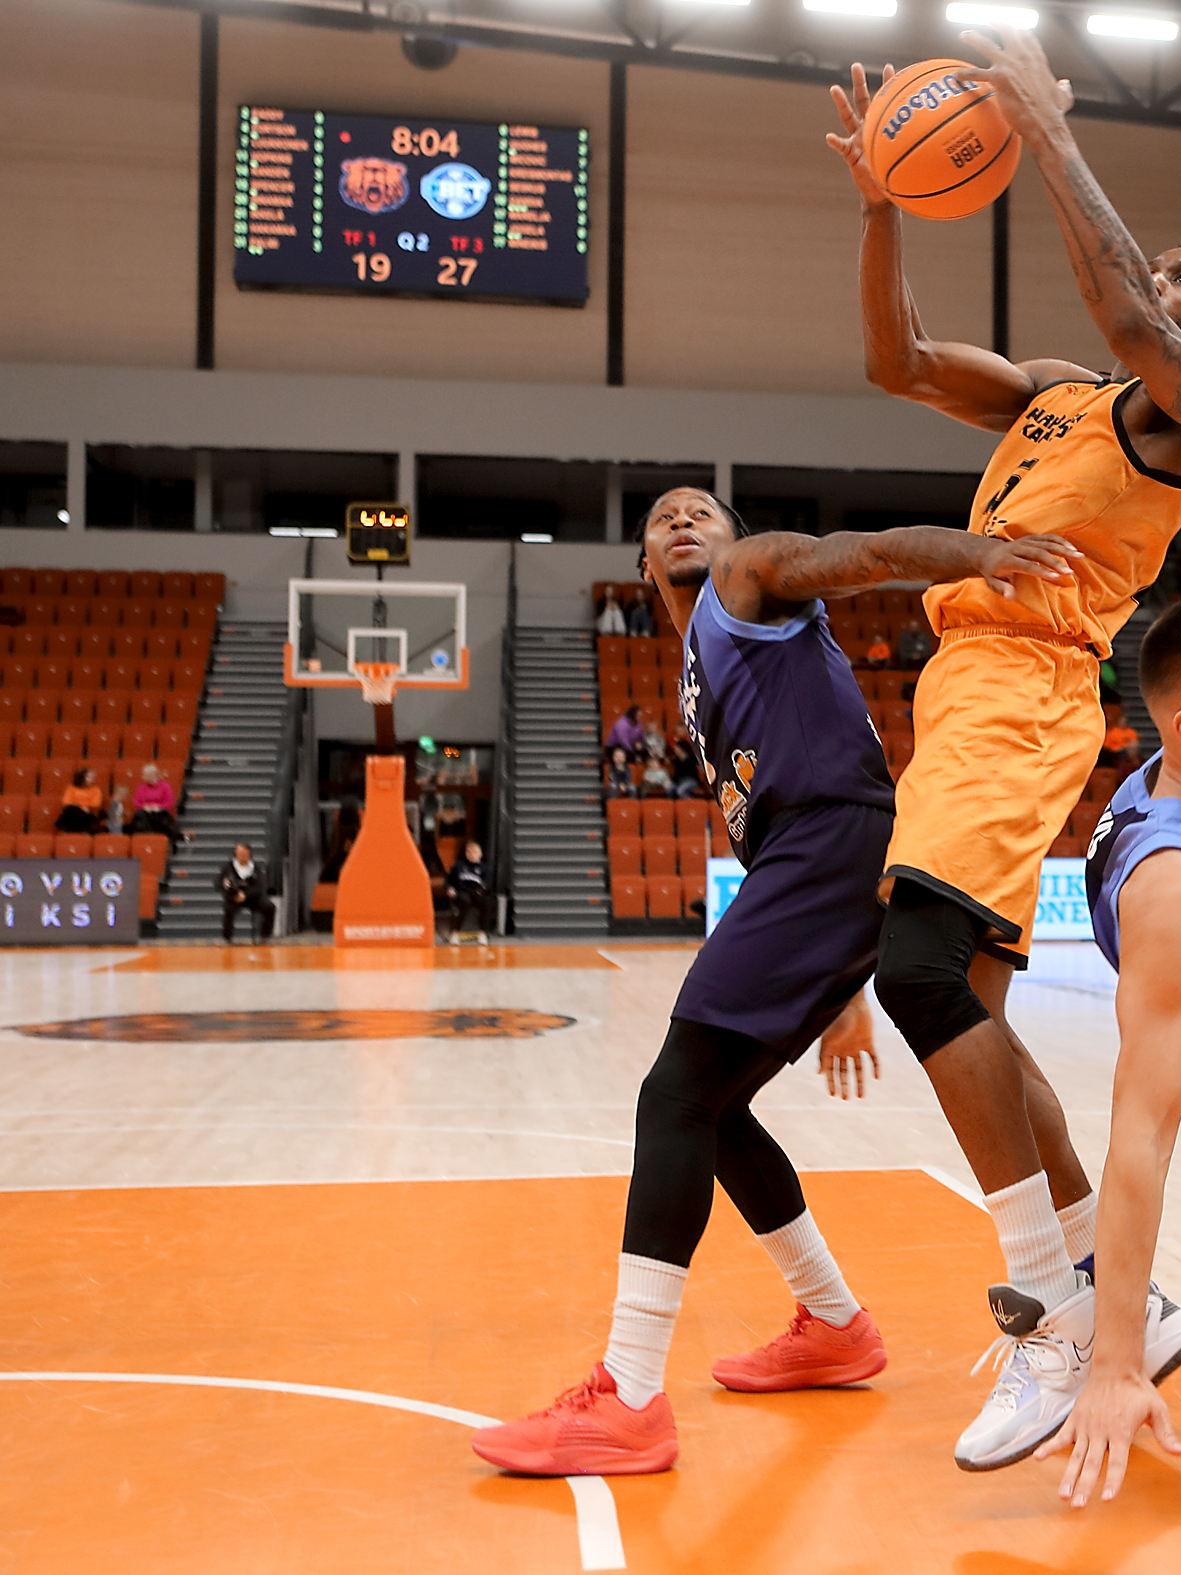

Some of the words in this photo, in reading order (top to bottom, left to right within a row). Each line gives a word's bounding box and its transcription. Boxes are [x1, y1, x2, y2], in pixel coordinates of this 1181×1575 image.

[882, 71, 980, 142] Wilson
[391, 125, 460, 158] 8:04
[949, 137, 985, 169] FIBA
[367, 231, 377, 248] 1
[352, 251, 393, 283] 19
[437, 255, 479, 287] 27
